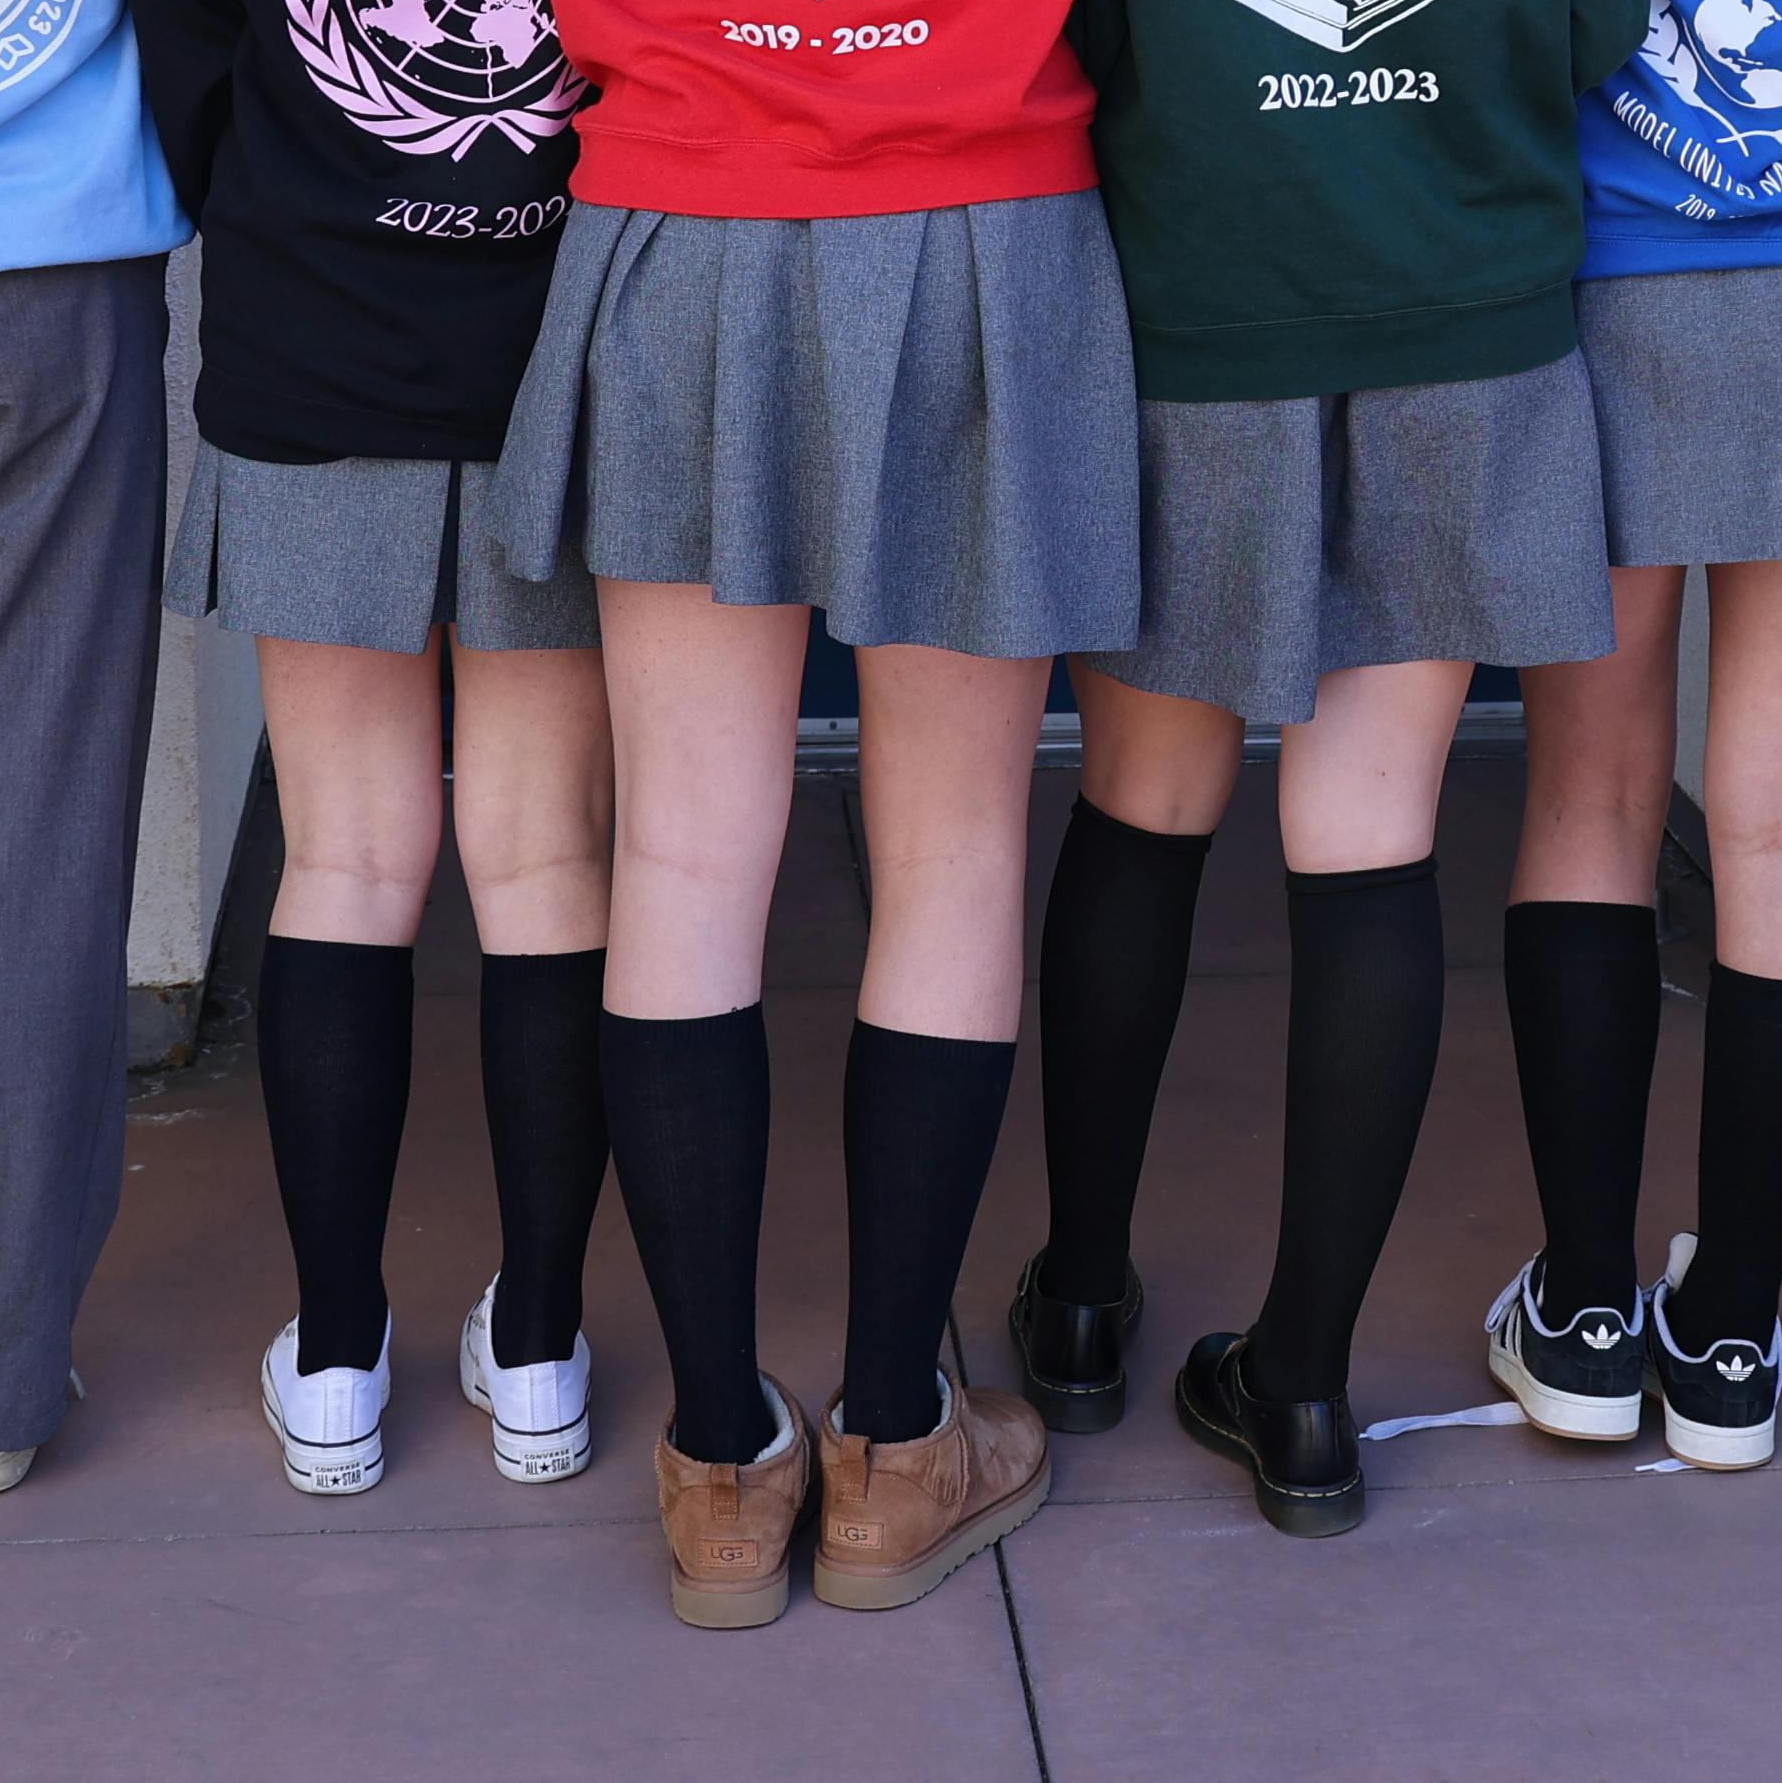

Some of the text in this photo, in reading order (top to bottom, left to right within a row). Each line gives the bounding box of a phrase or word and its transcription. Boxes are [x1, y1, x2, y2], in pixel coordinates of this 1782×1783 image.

[720, 19, 800, 50] 2019
[831, 18, 930, 55] 2020
[1257, 67, 1441, 110] 2022-2023
[1613, 91, 1678, 159] MODEL
[375, 195, 569, 239] 2023-202
[1674, 194, 1717, 221] 2019
[316, 1469, 362, 1488] ALL STAR
[525, 1456, 570, 1475] ALL STAR
[837, 1523, 868, 1541] UGG
[710, 1546, 744, 1562] UGG
